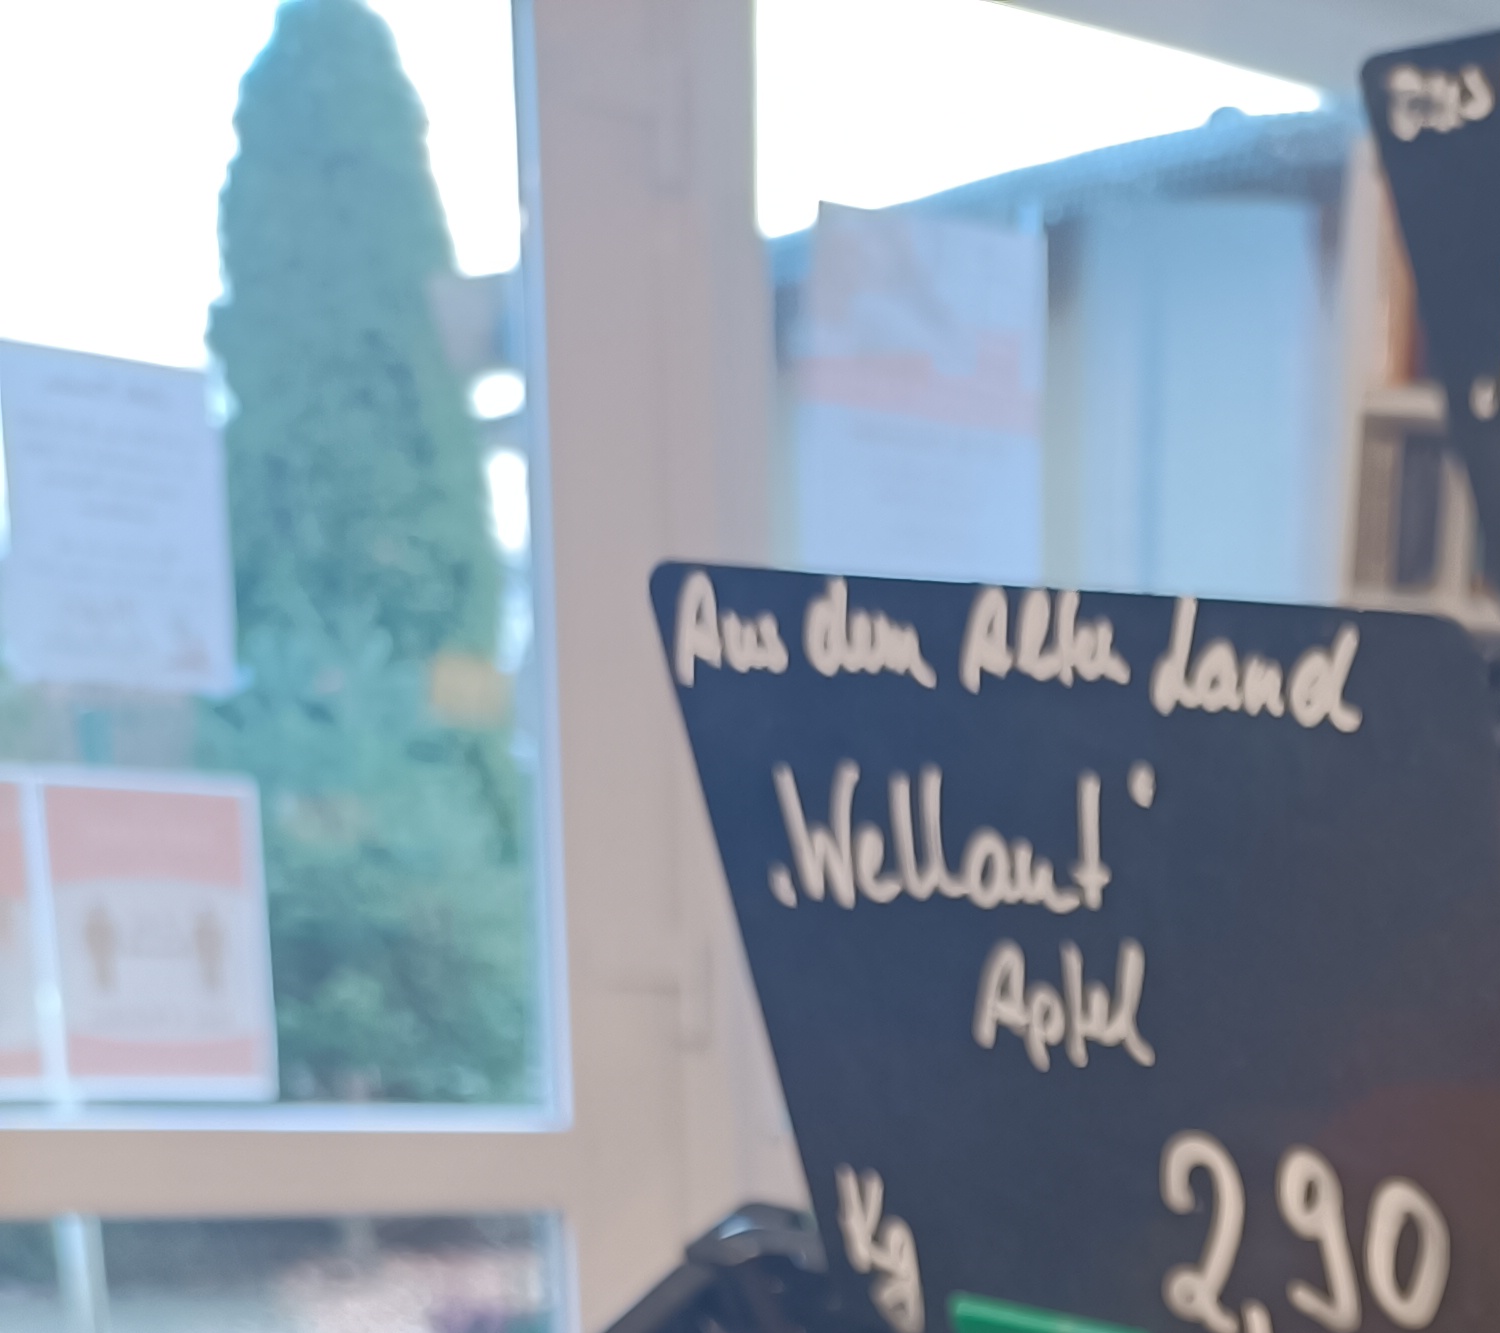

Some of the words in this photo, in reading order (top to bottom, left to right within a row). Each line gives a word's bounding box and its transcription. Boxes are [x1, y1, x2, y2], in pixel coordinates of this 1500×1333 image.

[675, 569, 789, 687] Aus
[805, 574, 936, 689] dem
[1150, 595, 1363, 733] Land
